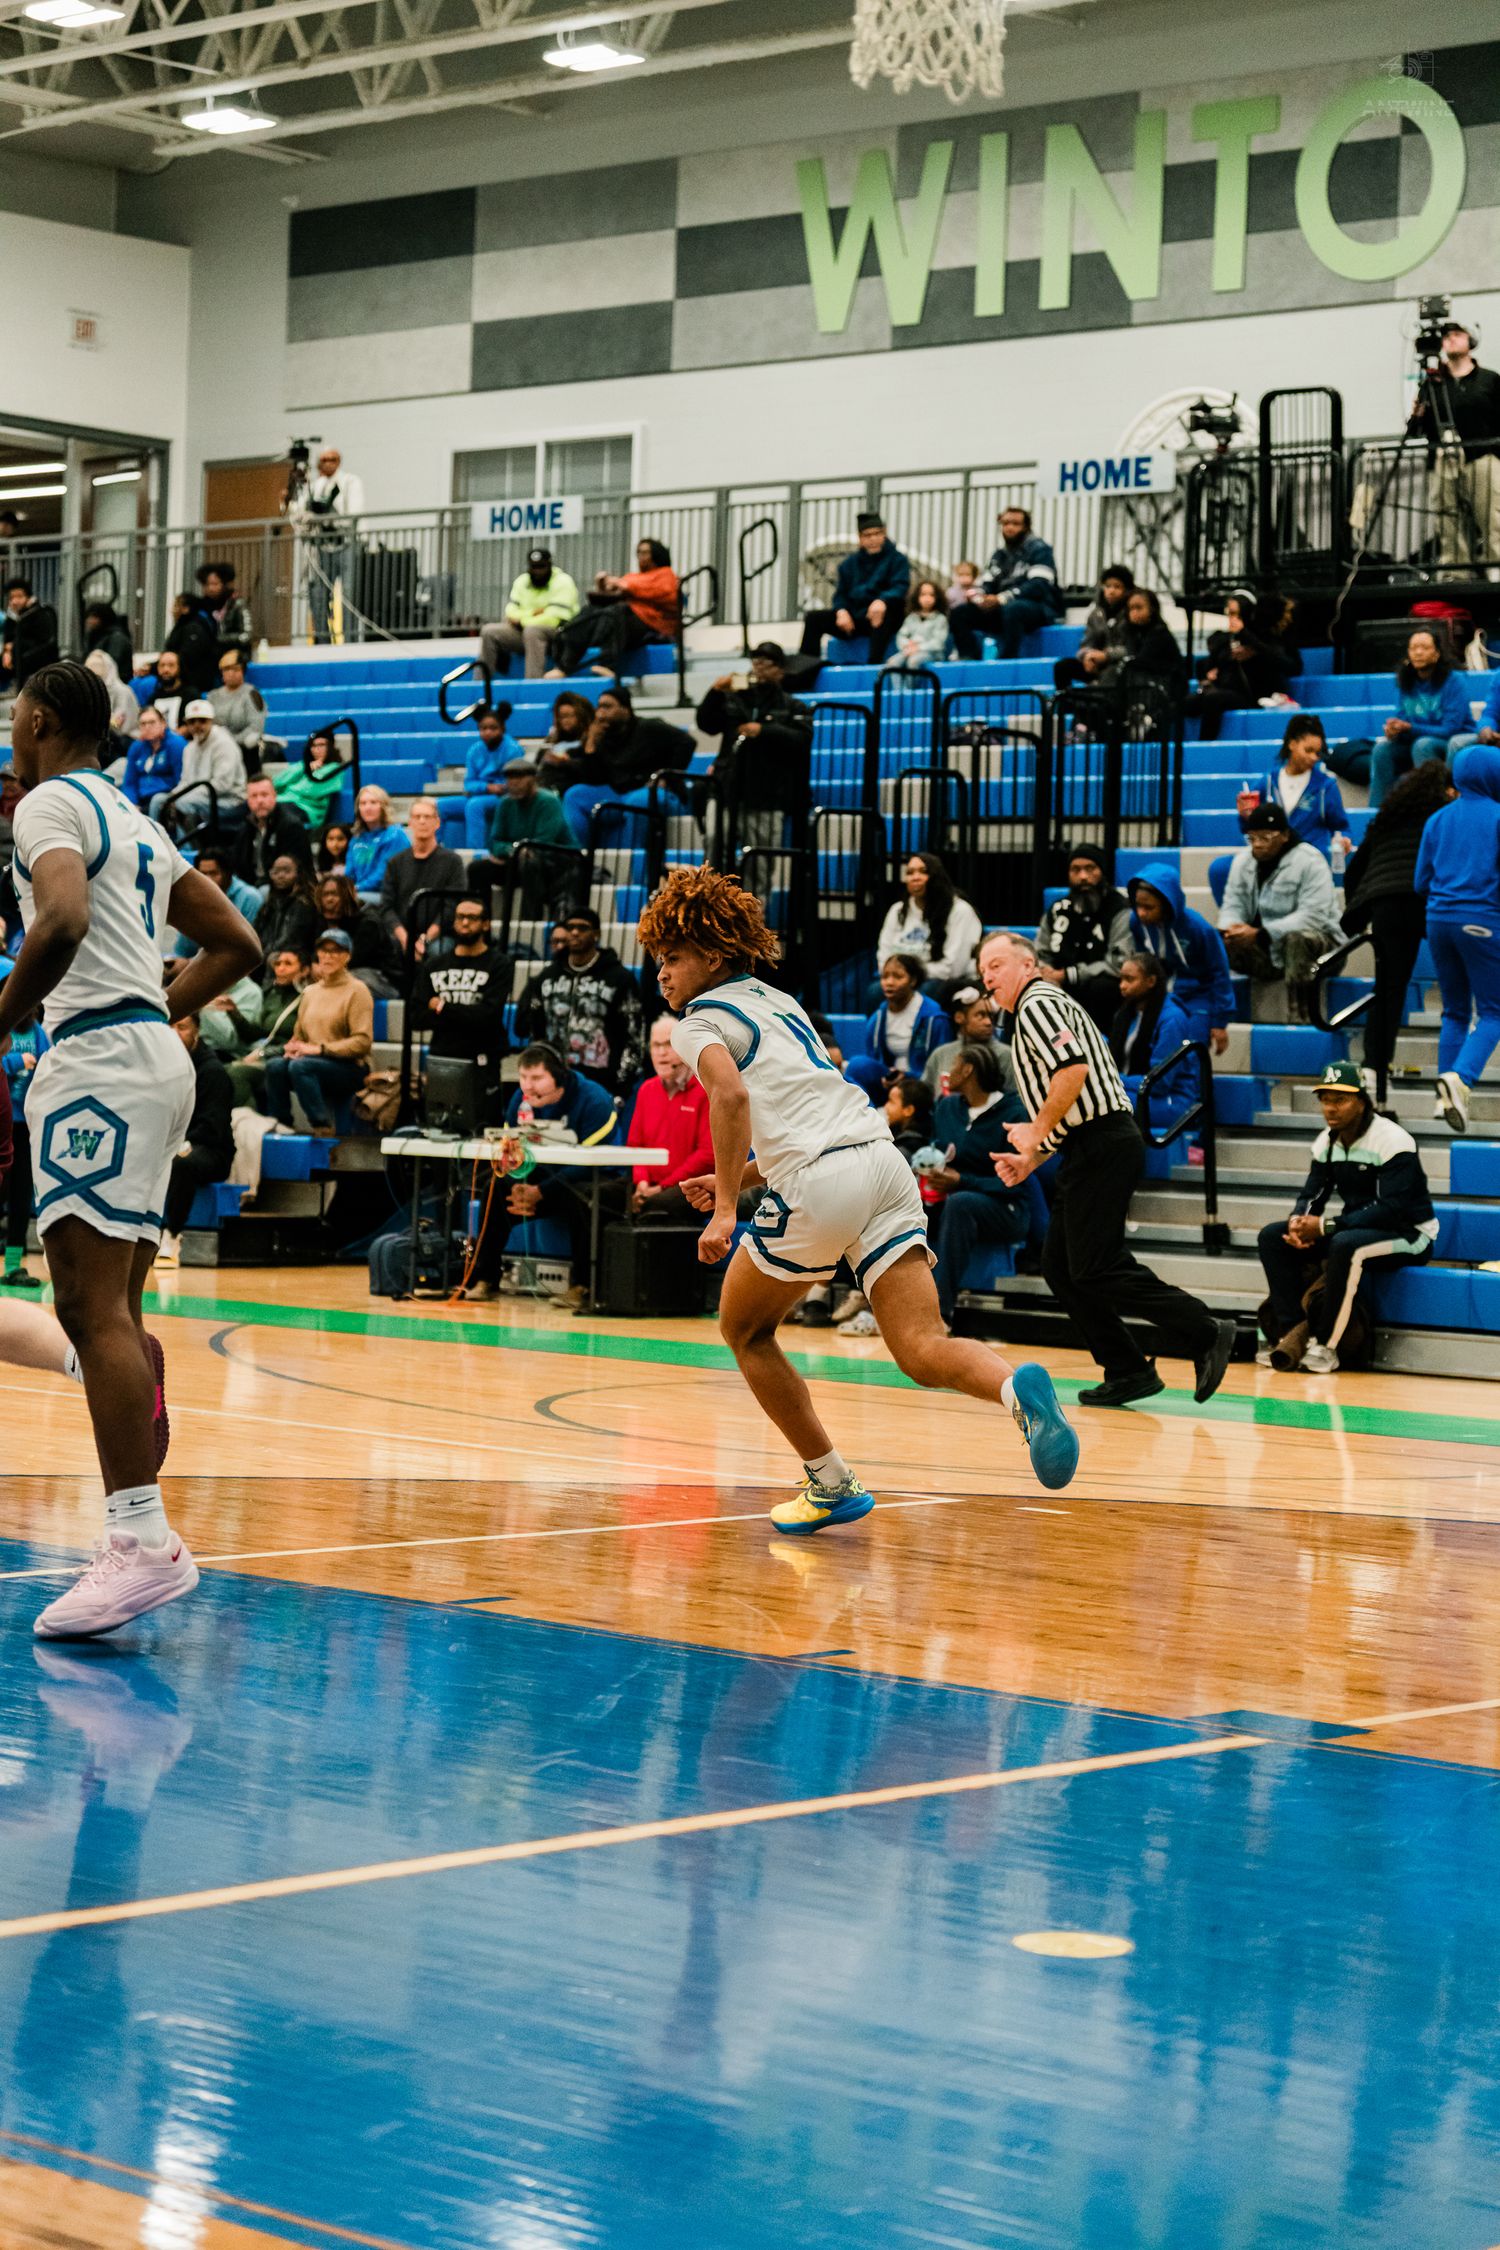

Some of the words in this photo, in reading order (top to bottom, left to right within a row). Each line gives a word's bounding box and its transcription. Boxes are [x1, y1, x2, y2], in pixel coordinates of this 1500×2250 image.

[795, 74, 1467, 334] WINTO
[1059, 456, 1152, 492] HOME
[490, 502, 563, 533] HOME
[135, 841, 155, 940] 5
[430, 968, 490, 993] KEEP
